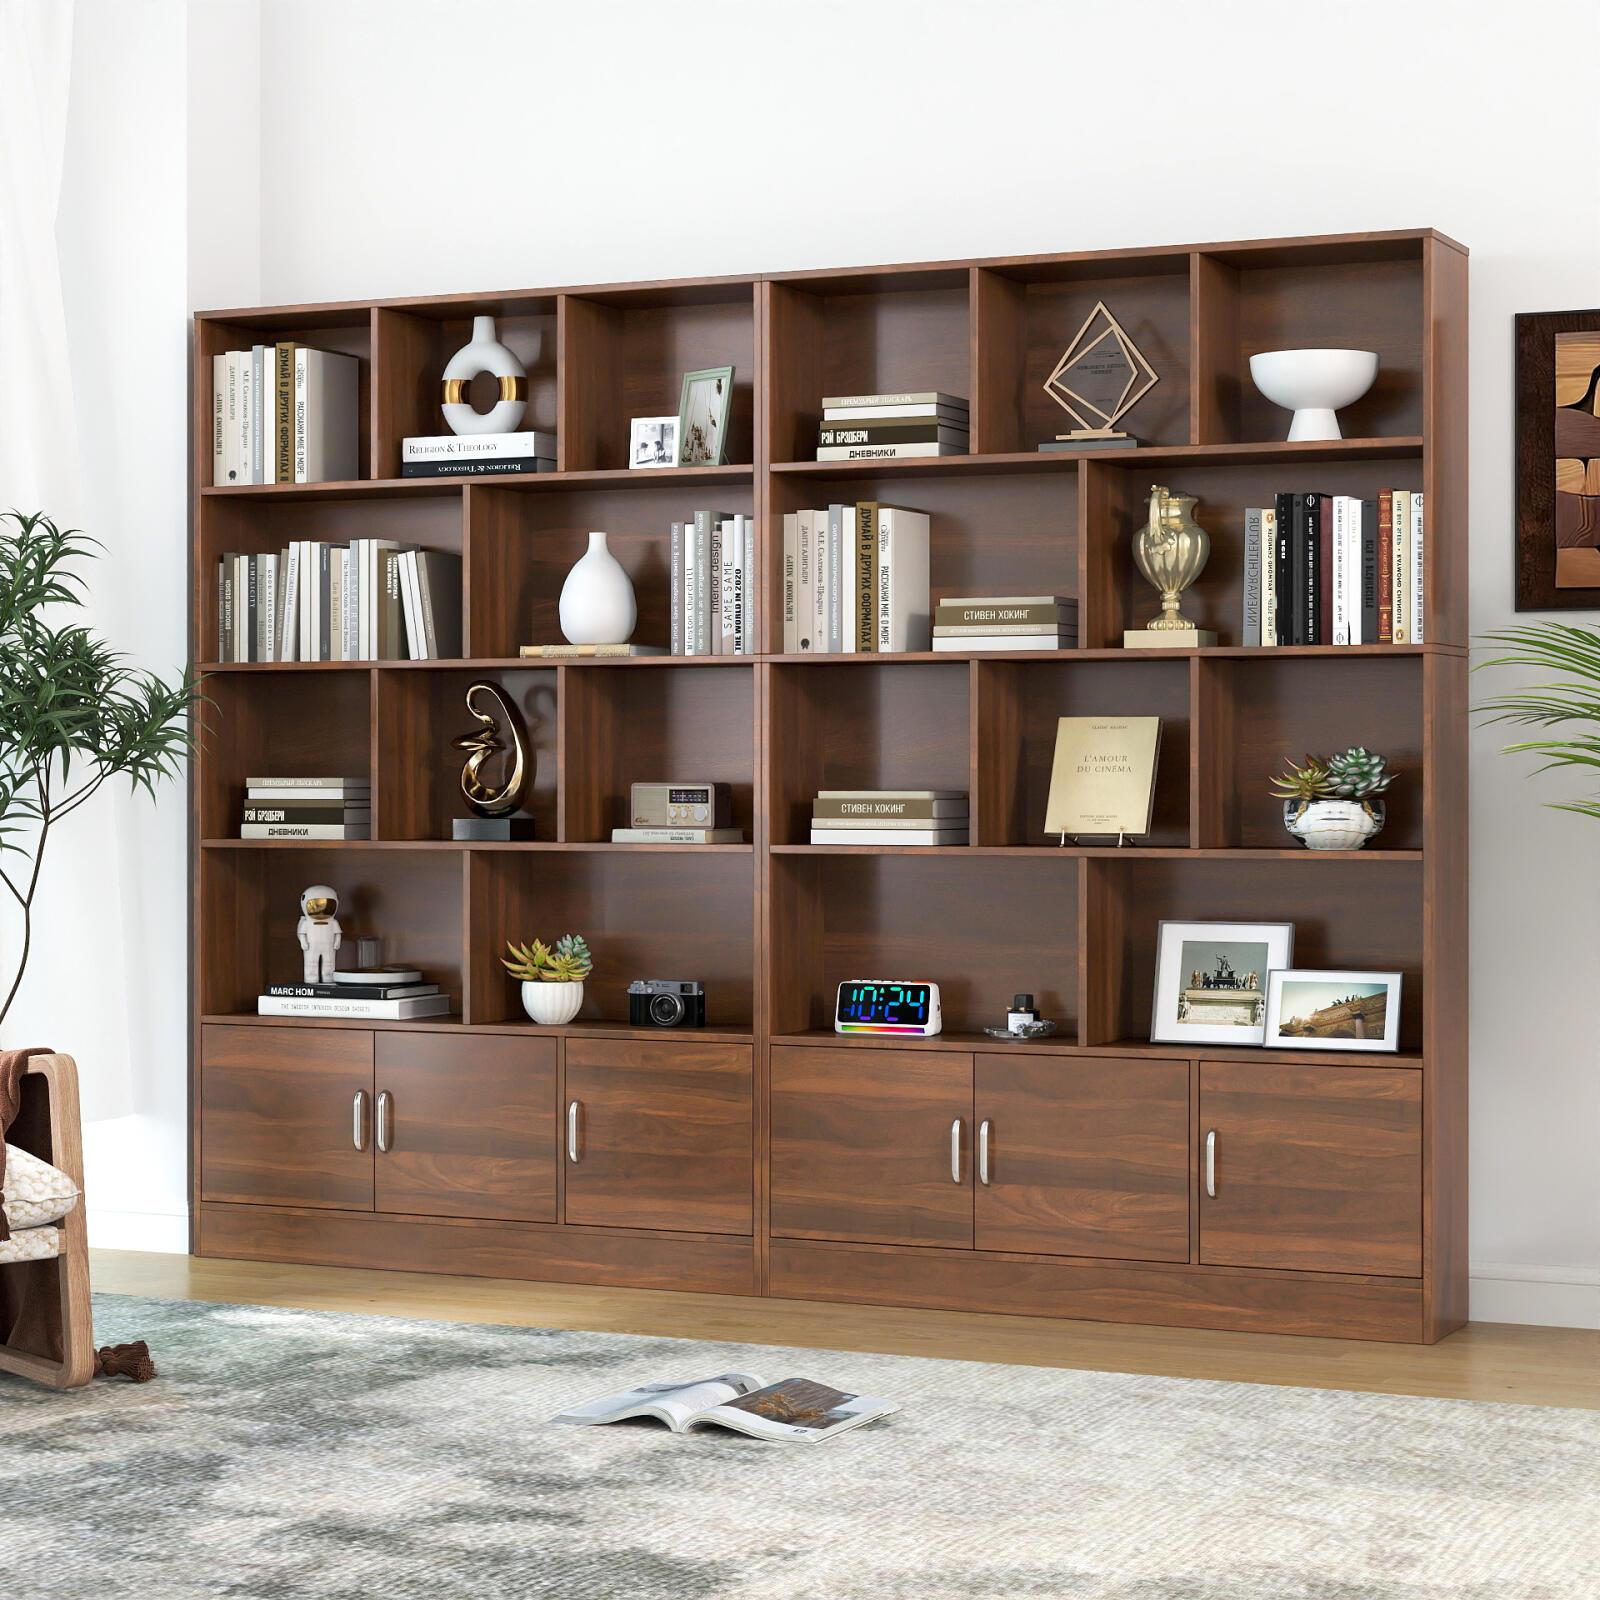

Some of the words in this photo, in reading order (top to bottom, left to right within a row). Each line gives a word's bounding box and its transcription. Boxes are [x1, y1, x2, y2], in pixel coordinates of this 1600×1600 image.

[279, 348, 290, 379] ДУМАЙ
[280, 391, 288, 424] ДРУГИХ
[297, 401, 305, 435] РАССКАЖИ
[280, 426, 288, 472] ФОРМАТАХ
[446, 444, 454, 452] &
[822, 430, 834, 444] РЭЙ
[836, 430, 868, 443] БРЭДБЕРИ
[297, 458, 305, 474] МОРЕ
[849, 449, 896, 458] ДНЕВНИКИ
[860, 508, 873, 541] ДУМАЙ
[711, 535, 721, 571] design
[724, 561, 732, 591] SAME
[860, 553, 871, 589] ДРУГИХ
[880, 566, 889, 601] РАССКАЖИ
[735, 593, 741, 602] IN
[880, 604, 889, 617] МНЕ
[724, 598, 732, 628] SAME
[860, 593, 871, 644] ФОРМАТАХ
[964, 610, 995, 620] СТИВЕН
[998, 609, 1030, 619] ХОКИНГ
[880, 626, 889, 645] МОРЕ
[841, 804, 872, 813] СТИВЕН
[875, 804, 905, 813] ХОКИНГ
[271, 987, 294, 995] MARC
[850, 987, 924, 1021] 10:24
